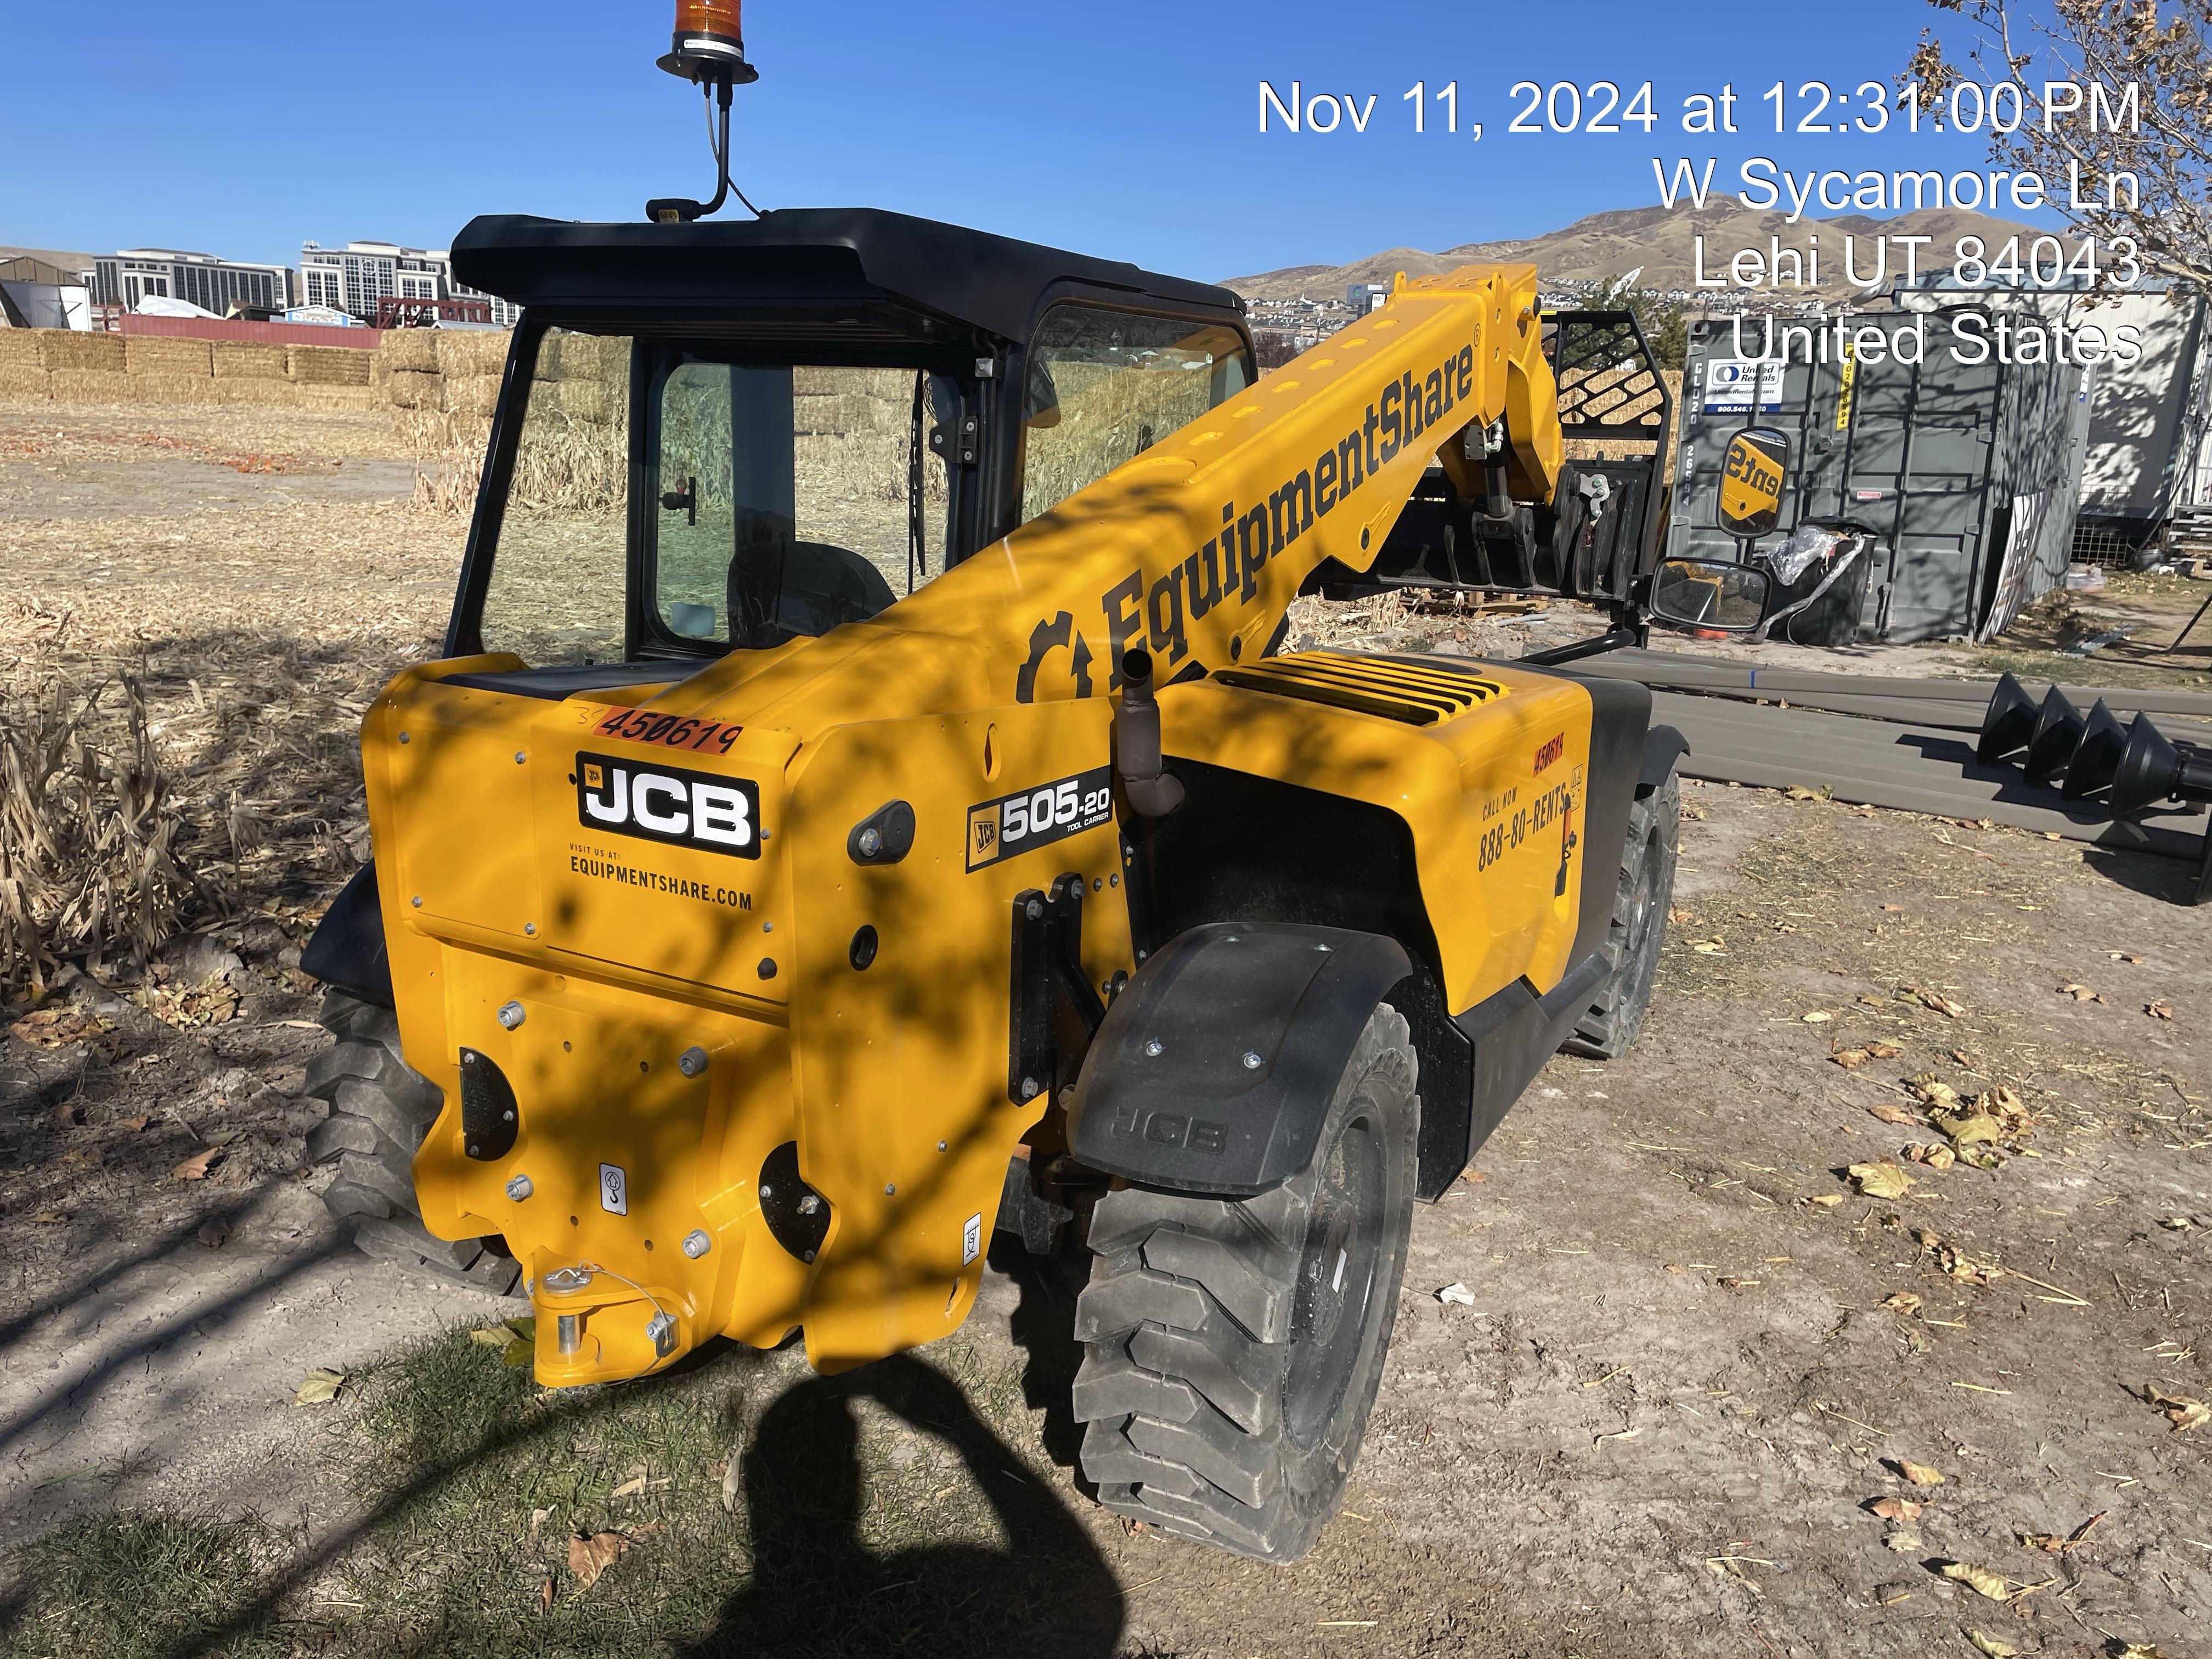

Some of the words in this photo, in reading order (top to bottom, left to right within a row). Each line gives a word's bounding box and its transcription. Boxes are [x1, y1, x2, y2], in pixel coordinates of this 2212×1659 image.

[1742, 365, 1775, 374] Unied
[1683, 445, 1694, 506] 26594
[600, 710, 743, 754] 450619
[1534, 731, 1564, 775] 450619
[586, 768, 751, 846] JCB
[1066, 821, 1082, 832] TOOL
[1084, 811, 1109, 826] CARRIER
[1482, 797, 1499, 822] CALL
[1502, 786, 1517, 810] NOW
[978, 823, 995, 850] JCB
[1479, 781, 1566, 872] 888-80-RENTS
[570, 843, 591, 854] VISIT
[595, 848, 604, 857] US
[608, 851, 620, 860] AT:
[571, 856, 752, 911] EQUIPMENTSHARE.COM
[1110, 1106, 1228, 1155] JCB
